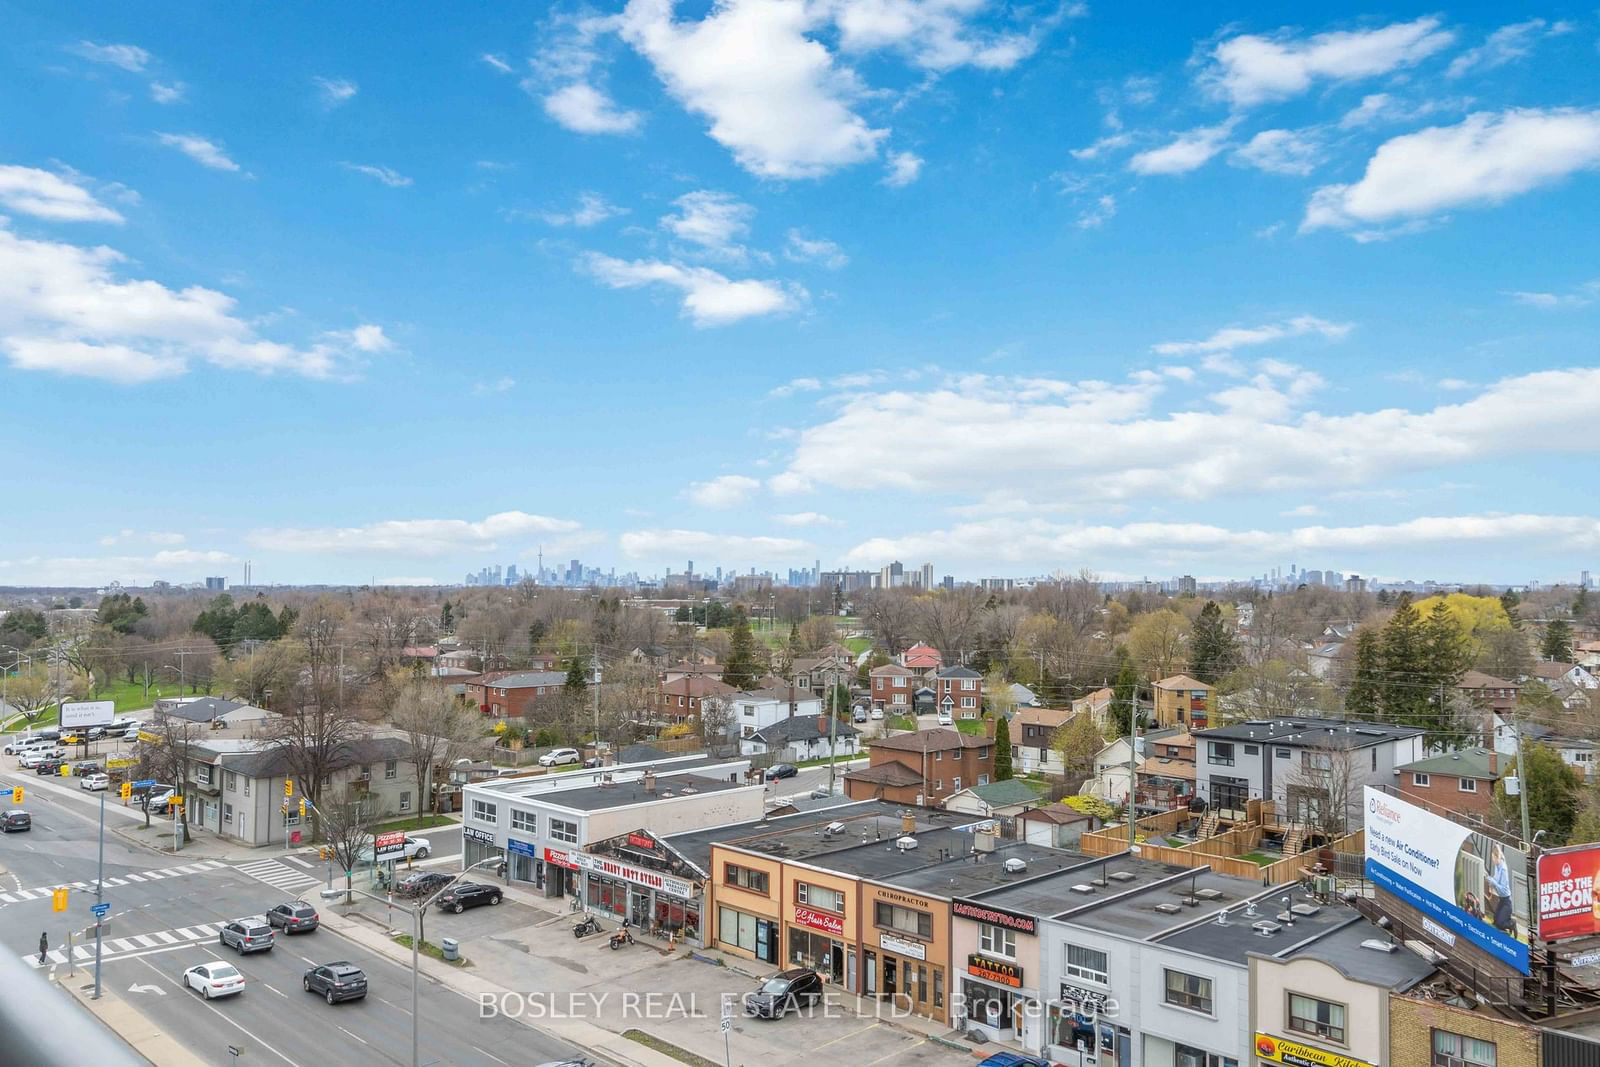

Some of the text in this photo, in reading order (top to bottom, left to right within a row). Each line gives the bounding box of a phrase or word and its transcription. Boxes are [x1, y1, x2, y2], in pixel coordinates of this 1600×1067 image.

[1376, 800, 1401, 824] Reliance
[464, 826, 474, 838] LAW
[475, 828, 494, 841] OFFICE
[1369, 825, 1381, 840] Need
[1385, 836, 1396, 848] new
[1404, 844, 1440, 869] Conditioner?
[1369, 839, 1423, 877] Early Bird Sale on Now
[603, 861, 621, 876] HEAVY
[622, 867, 639, 881] DUTY
[640, 871, 662, 888] CYCLES
[665, 878, 689, 888] AUTHORIZED
[666, 882, 688, 893] WARRANTY
[1541, 876, 1592, 895] HERE'S THE
[877, 890, 929, 908] CHIROPRACTOR
[1540, 888, 1593, 912] BACON
[807, 912, 823, 926] Hair
[823, 917, 842, 930] Salon
[1424, 921, 1455, 947] OUTFRONT
[974, 957, 1014, 977] TATTOO
[721, 1020, 730, 1031] 50
[1277, 1041, 1326, 1062] Caribbean
